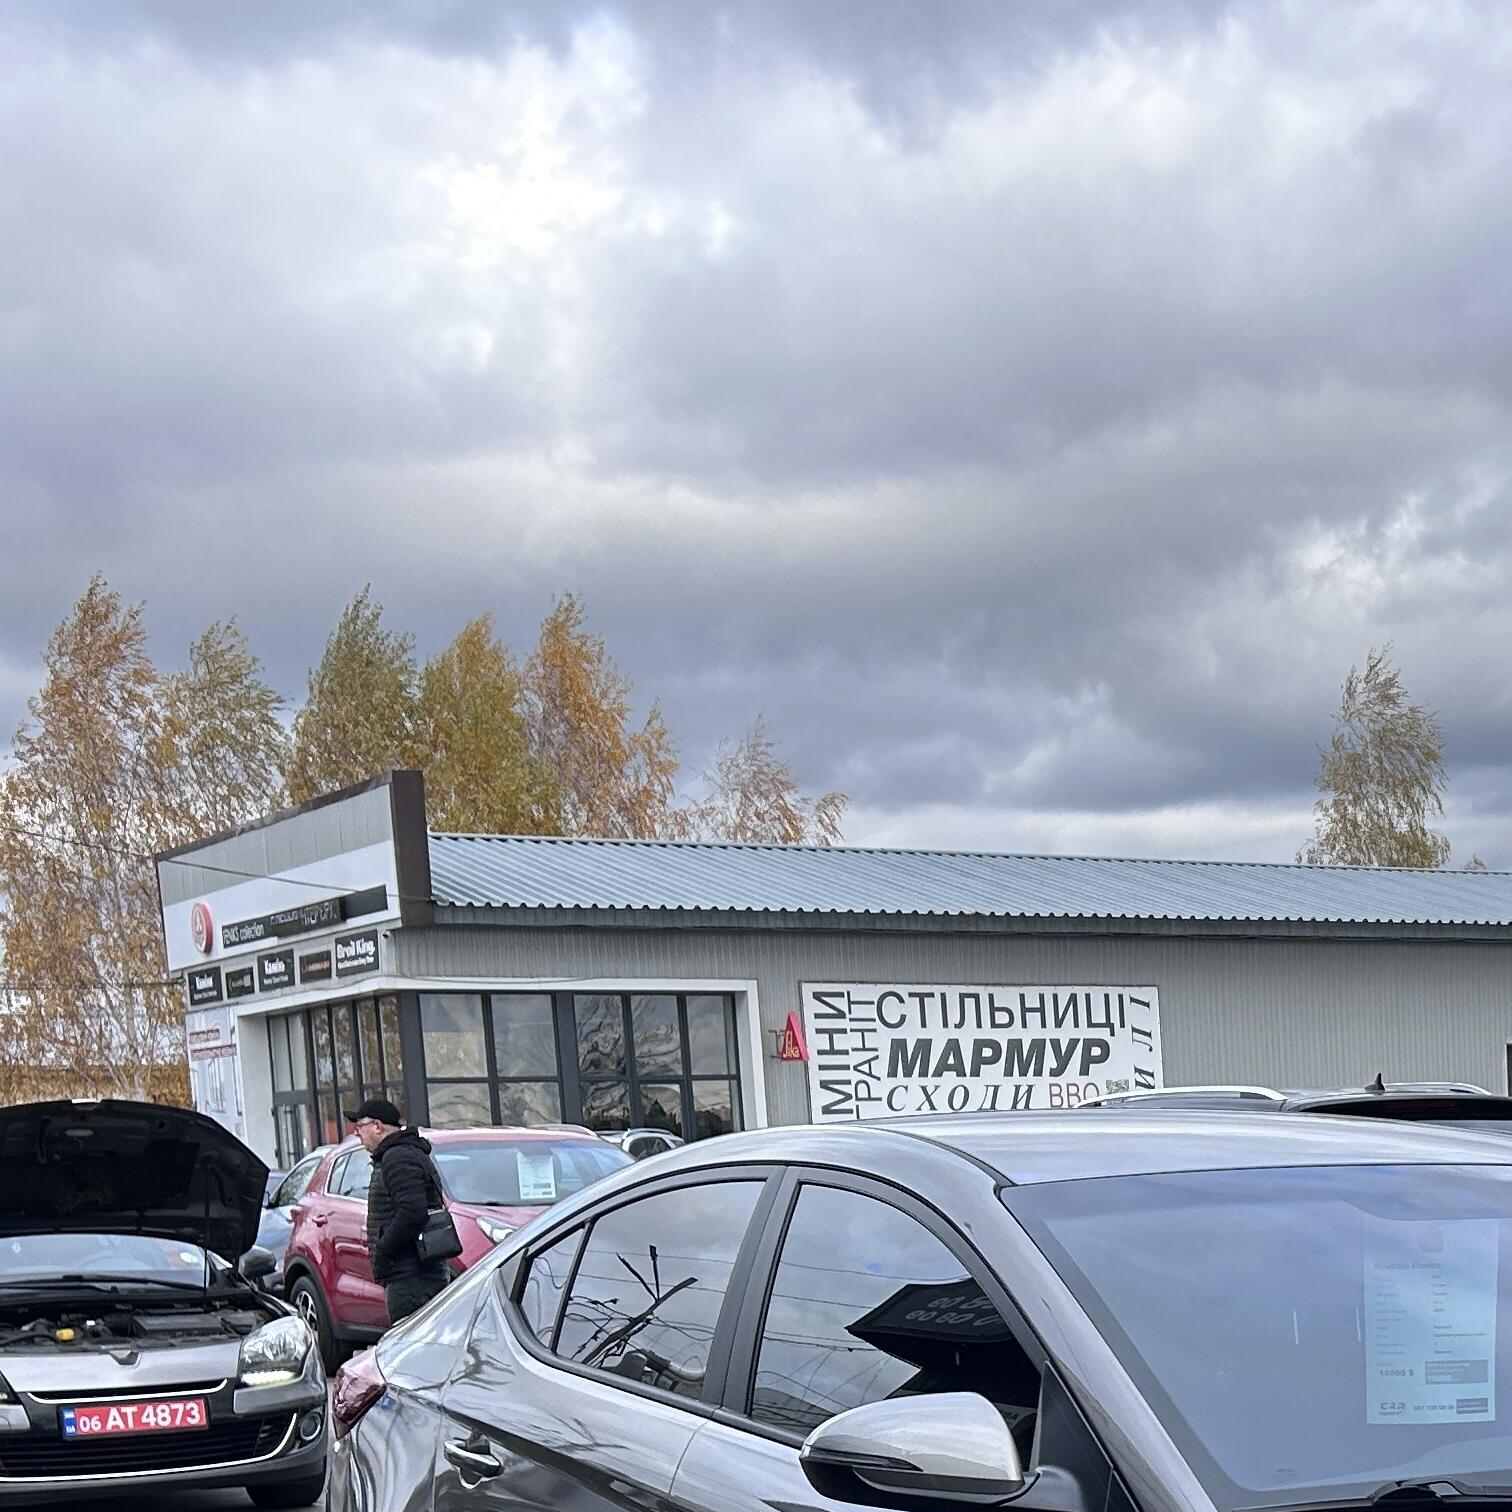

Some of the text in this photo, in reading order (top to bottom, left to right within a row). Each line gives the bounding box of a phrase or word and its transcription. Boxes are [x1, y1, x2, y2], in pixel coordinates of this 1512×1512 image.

[876, 990, 1126, 1037] СТІЛЬНИЦІ
[887, 1038, 1111, 1079] МАРМУР
[886, 1082, 1034, 1112] СХОДИ
[79, 1402, 201, 1433] 06 AT 4873
